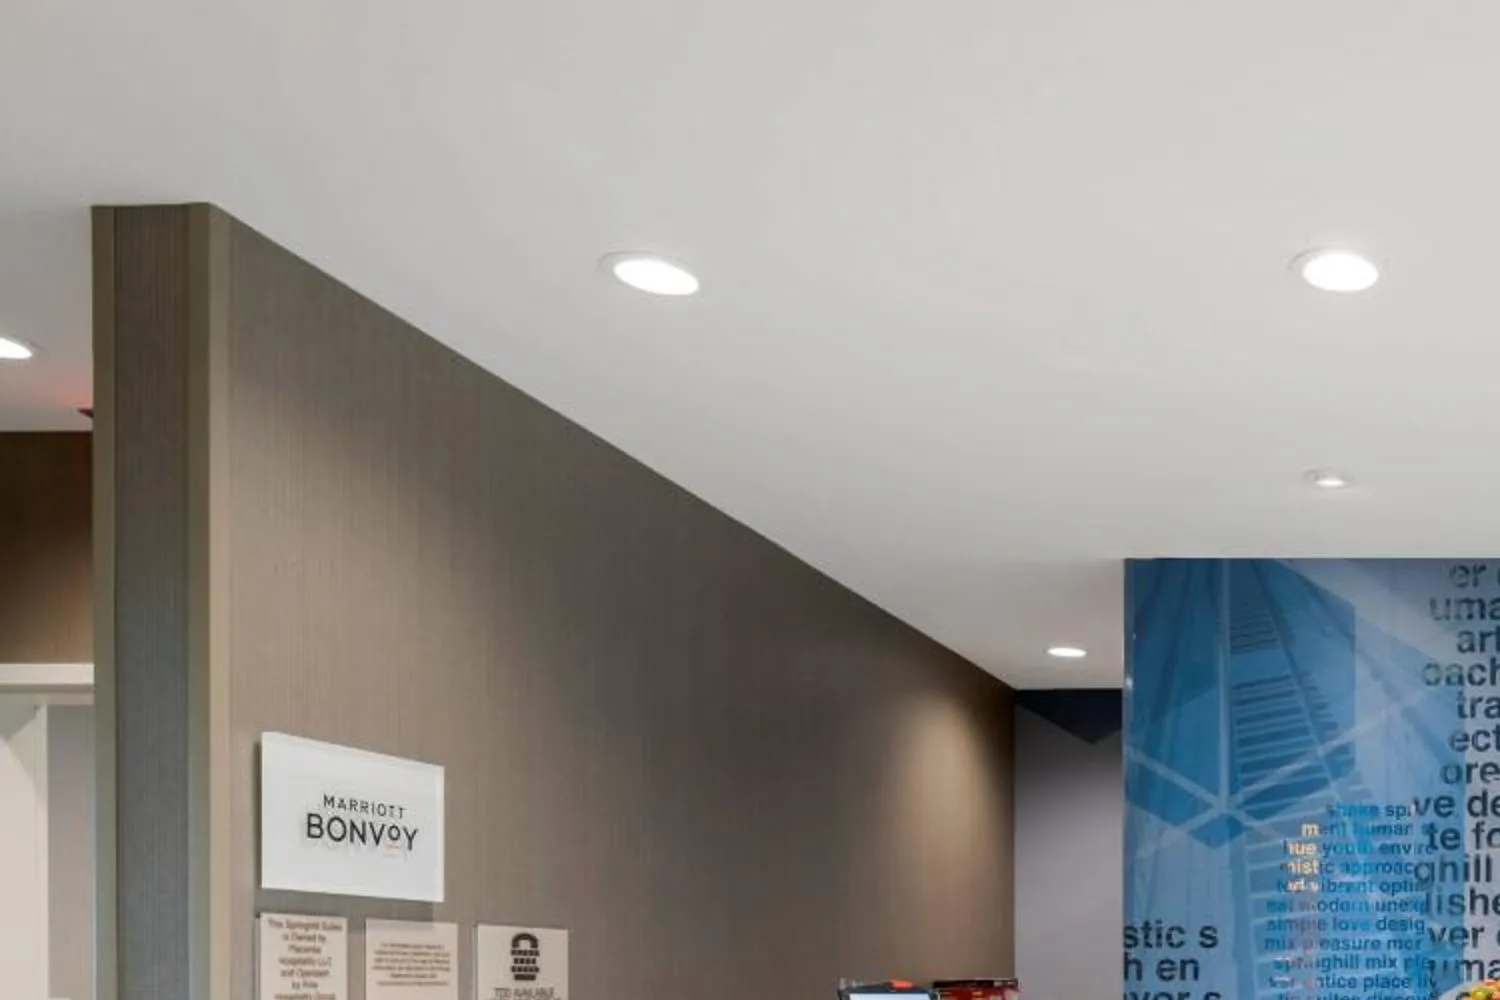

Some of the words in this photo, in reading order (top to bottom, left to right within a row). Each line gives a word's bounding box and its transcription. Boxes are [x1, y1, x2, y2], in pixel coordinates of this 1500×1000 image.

[1440, 761, 1500, 785] ore
[323, 794, 407, 820] MARRIOTT
[1414, 794, 1455, 817] ve
[1425, 822, 1461, 850] te
[1123, 920, 1185, 949] stic
[1199, 925, 1218, 949] s
[1427, 926, 1485, 949] ver
[1124, 952, 1142, 981] h
[1156, 959, 1200, 981] en
